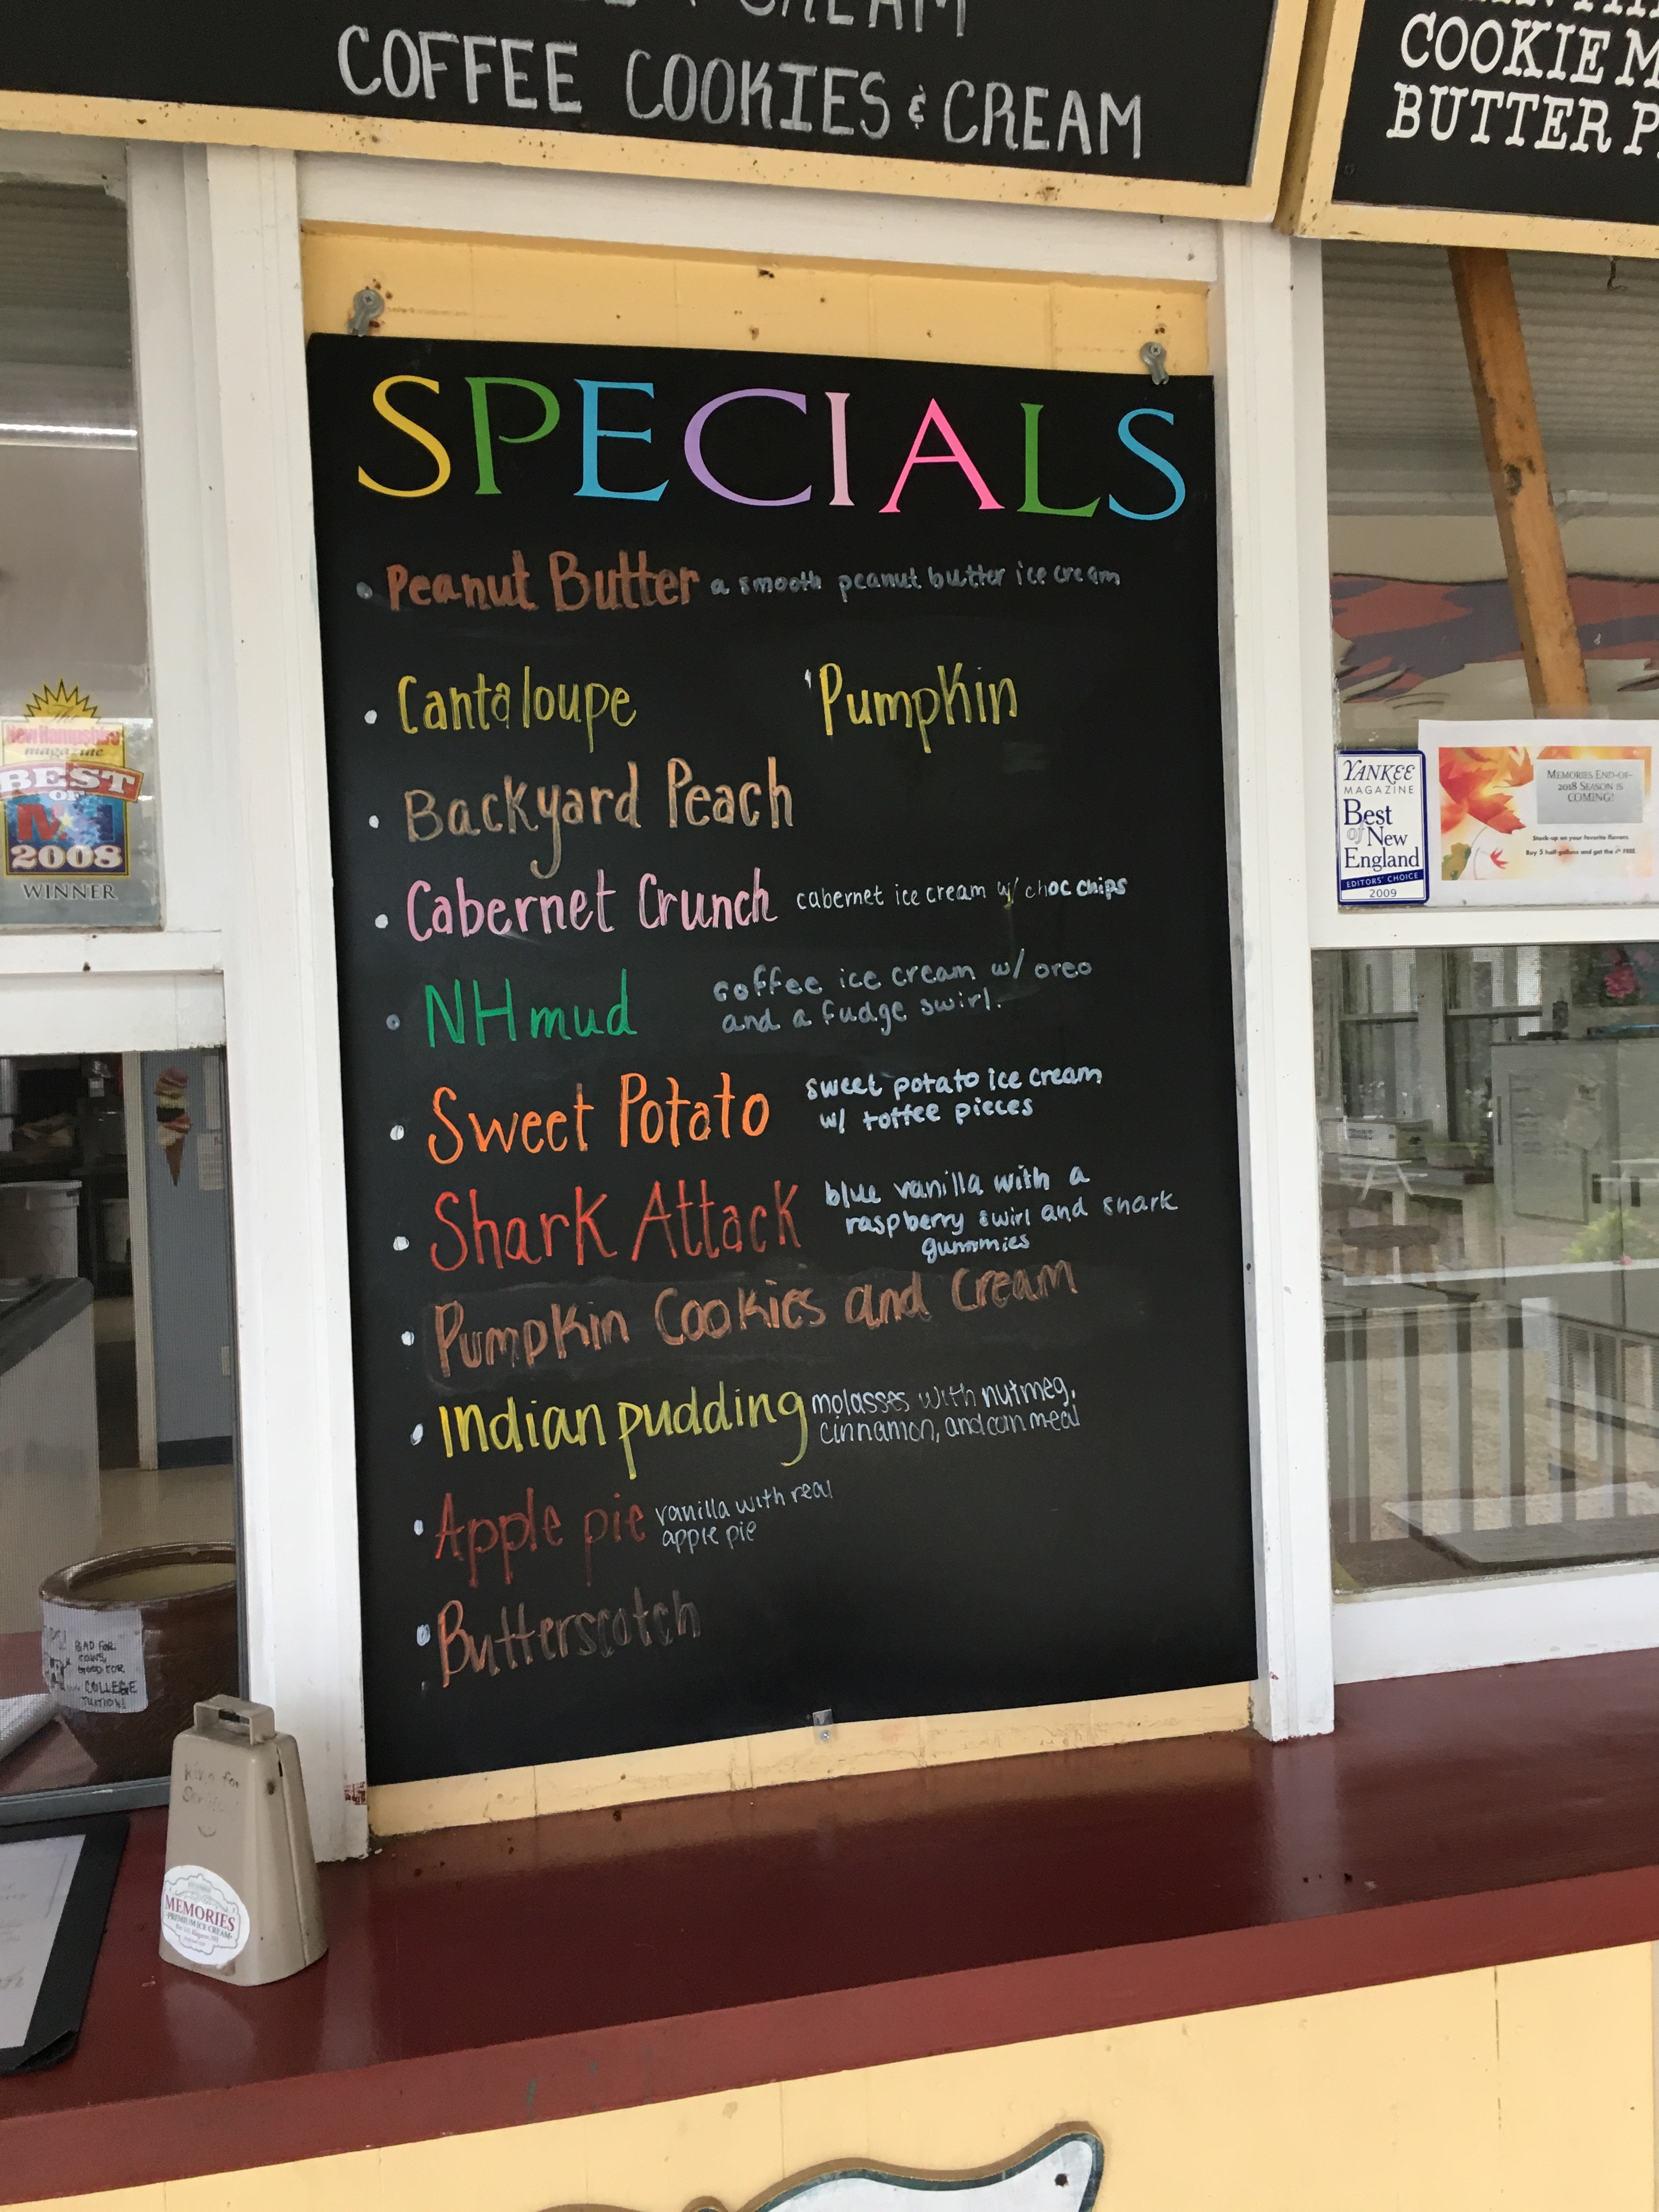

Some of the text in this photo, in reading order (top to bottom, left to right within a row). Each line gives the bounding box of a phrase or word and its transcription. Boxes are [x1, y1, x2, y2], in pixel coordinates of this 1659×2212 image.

[1401, 11, 1611, 84] COOKIE
[337, 25, 582, 114] COFFEE
[625, 48, 890, 140] COOKIES
[943, 78, 1142, 159] CREAM
[1386, 81, 1659, 159] BUTTER P
[358, 375, 1186, 520] SPECIALS
[386, 550, 1121, 612] Peanut Butter a smooth peanut butter ice cream
[397, 665, 636, 752] Cantaloupe
[819, 662, 1017, 754] Pumpkin
[0, 766, 136, 794] BEST
[1344, 760, 1416, 785] YANKEE
[1344, 785, 1414, 794] MAGAZINE
[1558, 781, 1578, 791] 2018
[404, 757, 793, 879] Backyard Peach
[1344, 798, 1393, 826] Best
[1347, 819, 1409, 847] of New
[11, 844, 123, 869] 2008
[1344, 847, 1420, 872] England
[22, 884, 117, 900] WINNER
[1369, 888, 1397, 898] 2009
[1387, 872, 1419, 883] CHOICE
[407, 869, 616, 941] Cabernet
[639, 867, 778, 931] Crunch
[797, 886, 884, 911] cabernet
[895, 884, 921, 907] ice
[926, 883, 986, 904] cream
[1025, 879, 1071, 900] choc
[1076, 876, 1128, 901] chips
[713, 948, 1093, 1002] coffee ice cream w/ oreo
[425, 968, 637, 1048] NH mud
[721, 986, 1001, 1036] and a fudge swirl.
[805, 1065, 1103, 1100] sweet potato ice cream
[428, 1072, 769, 1164] Sweet Potato
[820, 1097, 1034, 1133] w/ toffee pieces
[825, 1165, 1090, 1207] blue vanilla with a
[430, 1180, 802, 1272] Shark Attack
[845, 1210, 964, 1238] raspberry
[979, 1207, 1030, 1228] swirl
[1042, 1197, 1088, 1223] and
[921, 1233, 1030, 1263] gummies
[435, 1260, 1078, 1376] Pumpkin Cookies and Cream
[811, 1389, 910, 1414] molasses
[919, 1383, 977, 1410] with
[439, 1380, 808, 1480] Indian pudding
[945, 1413, 985, 1437] and
[1029, 1404, 1081, 1432] meal
[656, 1479, 833, 1526] vanilla with real
[435, 1487, 646, 1587] Apple pie
[662, 1520, 758, 1554] apple pie
[438, 1586, 701, 1688] Butterscotch
[84, 1680, 138, 1695] COLLEGE
[165, 1894, 236, 1932] MEMORIES
